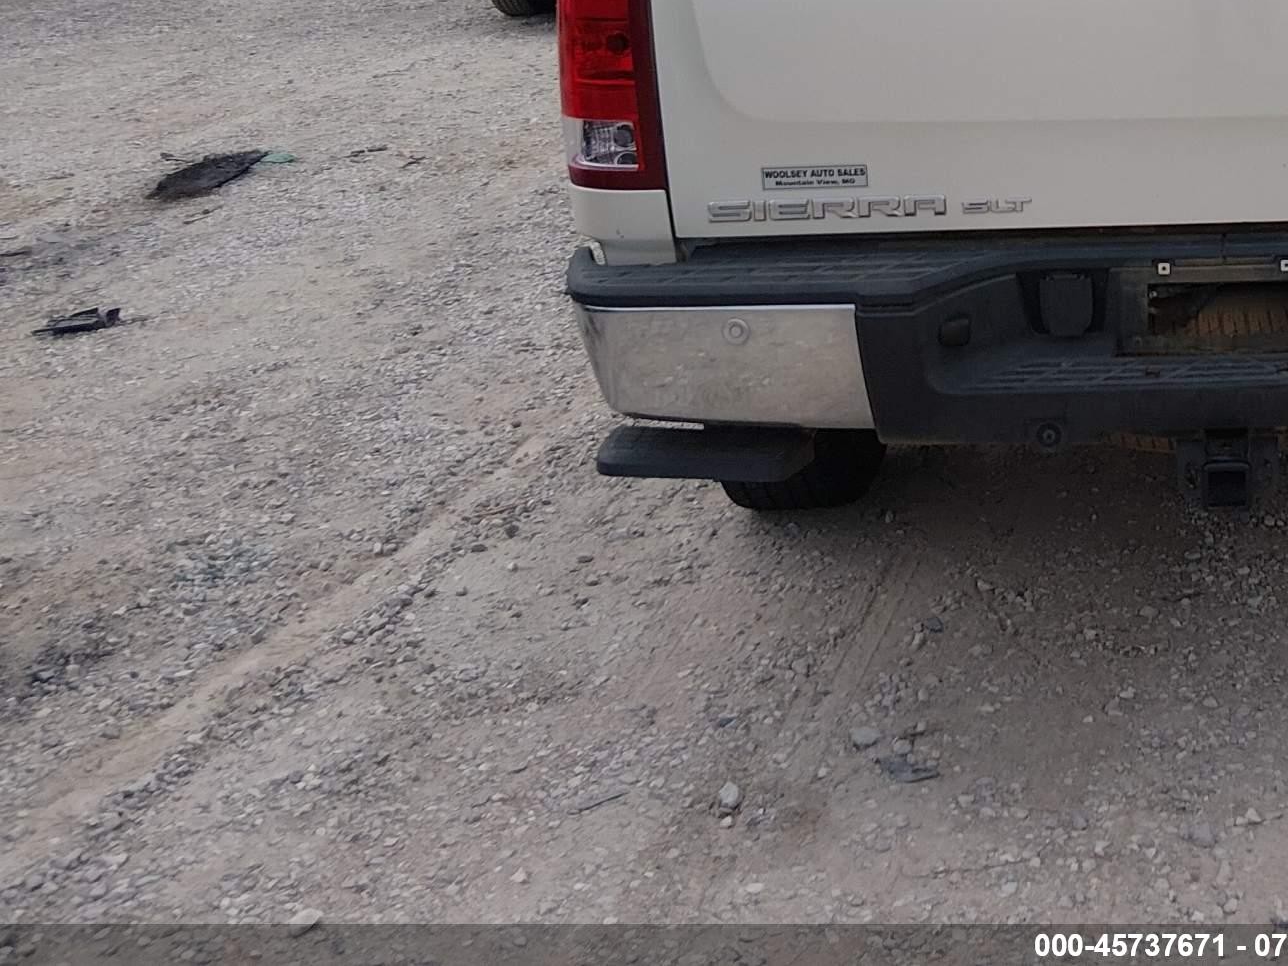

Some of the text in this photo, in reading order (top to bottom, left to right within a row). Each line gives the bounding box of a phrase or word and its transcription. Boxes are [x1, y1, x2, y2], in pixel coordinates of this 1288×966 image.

[764, 167, 866, 179] WOOLSEY AUTO SALES
[708, 195, 1033, 223] SIERRA SLT
